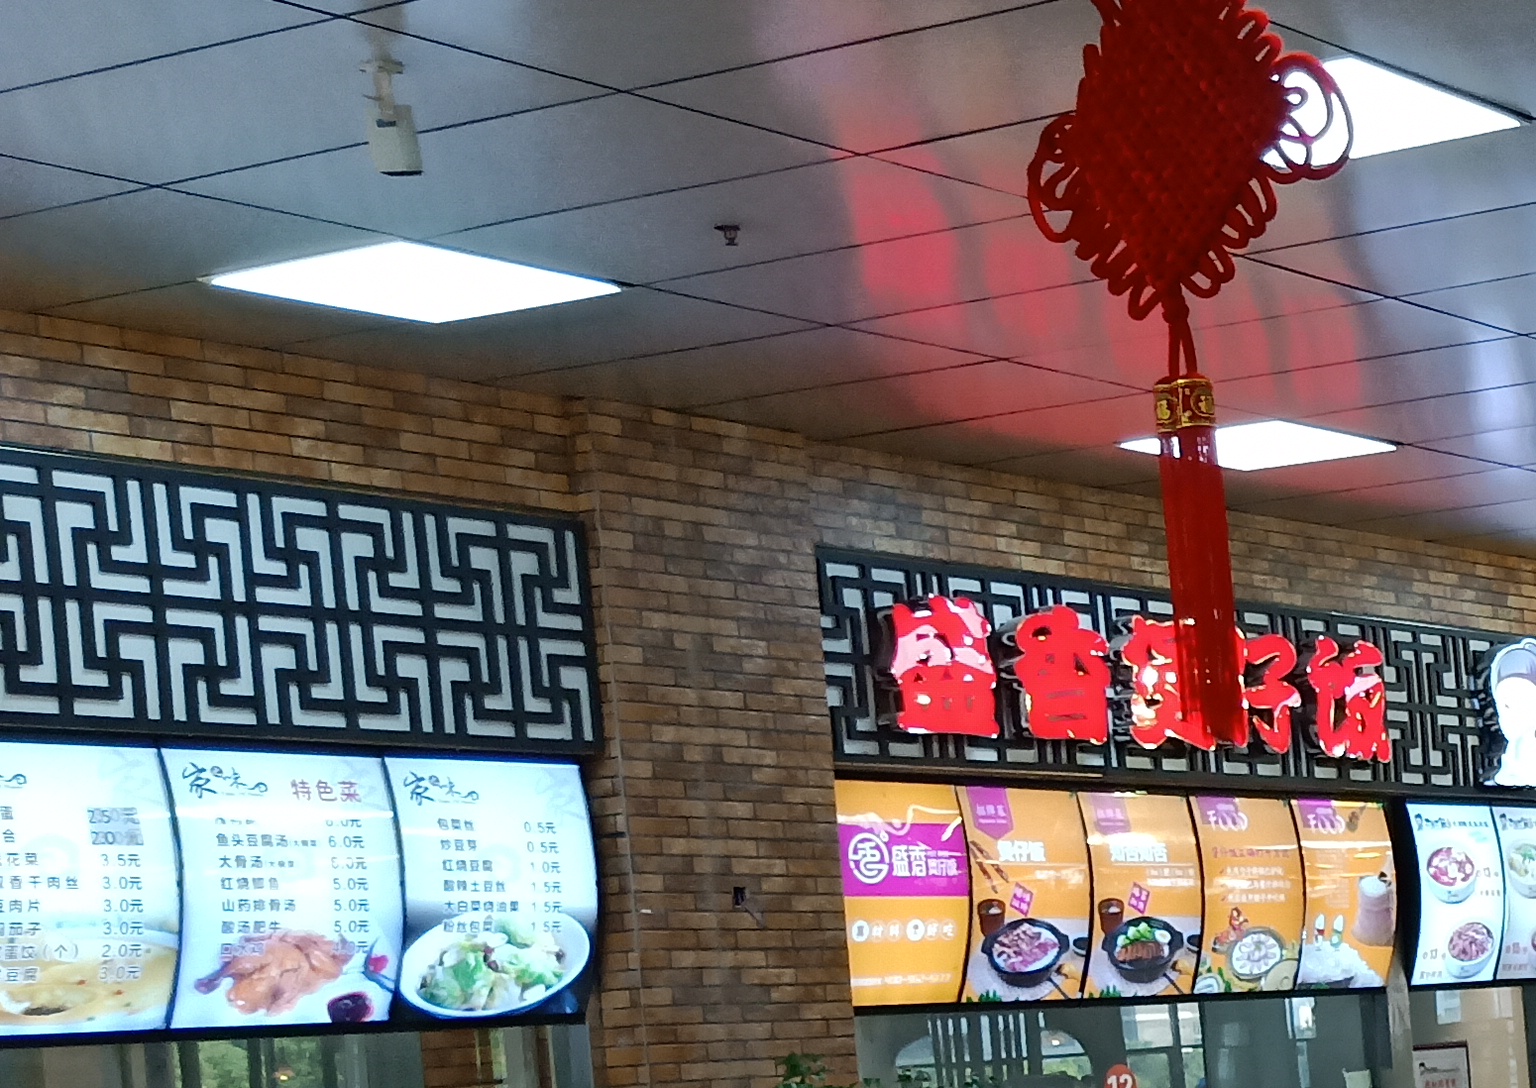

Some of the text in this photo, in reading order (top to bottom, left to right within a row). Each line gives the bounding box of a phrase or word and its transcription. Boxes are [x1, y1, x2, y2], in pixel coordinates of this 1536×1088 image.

[290, 779, 362, 803] 特色菜
[328, 836, 365, 849] 6.0元
[0, 852, 141, 868] 花菜 3.5元
[102, 876, 143, 891] 3.0元
[333, 878, 369, 891] 5.0元
[103, 899, 144, 914] 3.0元
[334, 899, 370, 912] 5.0元
[103, 922, 144, 936] 3.0元
[334, 920, 370, 934] 5.0元
[101, 944, 142, 958] 2.0元
[0, 966, 140, 982] 豆腐 3.0元
